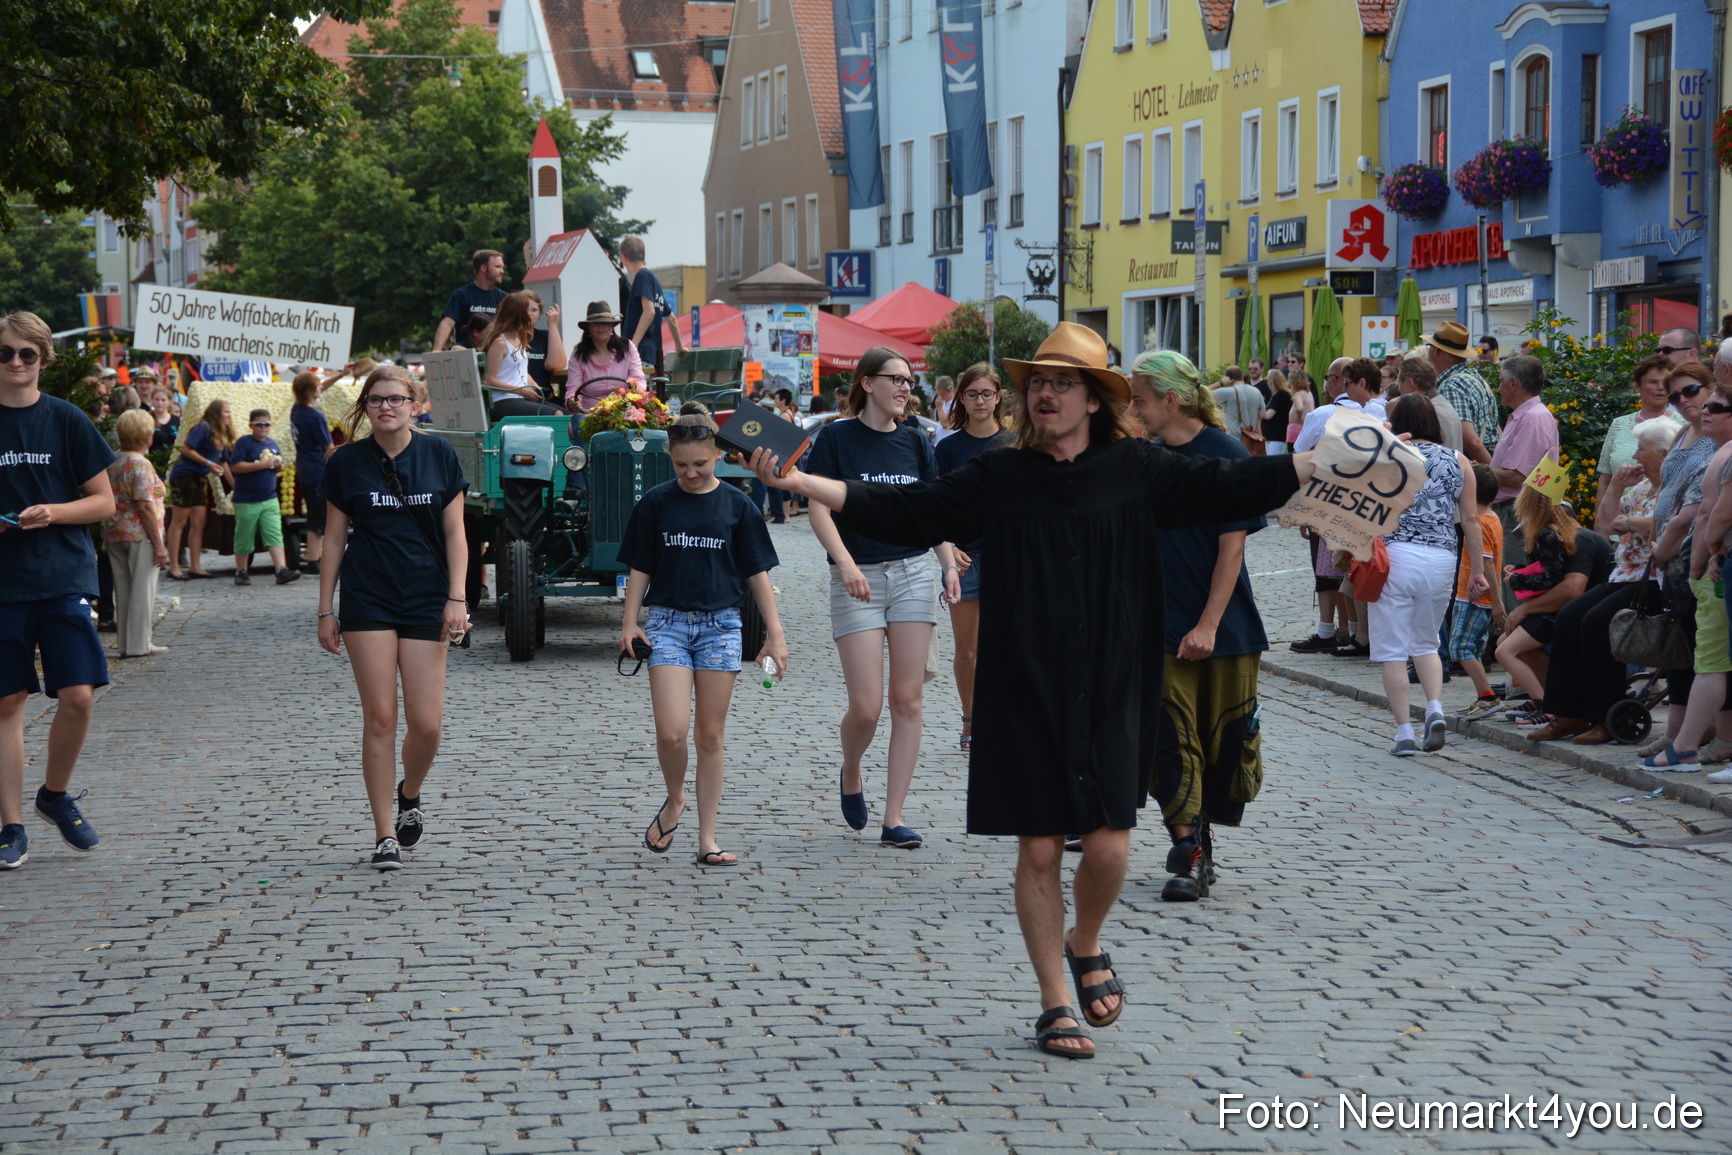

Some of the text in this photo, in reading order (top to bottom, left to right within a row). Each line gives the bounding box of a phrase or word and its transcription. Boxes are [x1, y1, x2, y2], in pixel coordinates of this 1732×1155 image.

[942, 7, 977, 92] K&L
[841, 32, 872, 112] K&L
[1133, 77, 1219, 122] HOTEL Lehmeier
[1680, 101, 1702, 214] WITTL
[1175, 241, 1219, 250] TAIUN
[1262, 222, 1297, 246] TAIFUN
[1408, 222, 1502, 269] APOTHEE
[1128, 258, 1179, 283] Restaurant
[1500, 284, 1525, 298] APOTHEKE
[149, 292, 340, 334] 50 Jahre Woffabecka Kirch
[156, 322, 330, 363] Mini's machen's möglich
[832, 357, 851, 366] Hotel
[1331, 426, 1426, 498] 95
[1531, 474, 1547, 488] 50
[1304, 476, 1393, 526] THESEN
[662, 531, 725, 549] Lutheraner
[1322, 528, 1358, 551] Glauben
